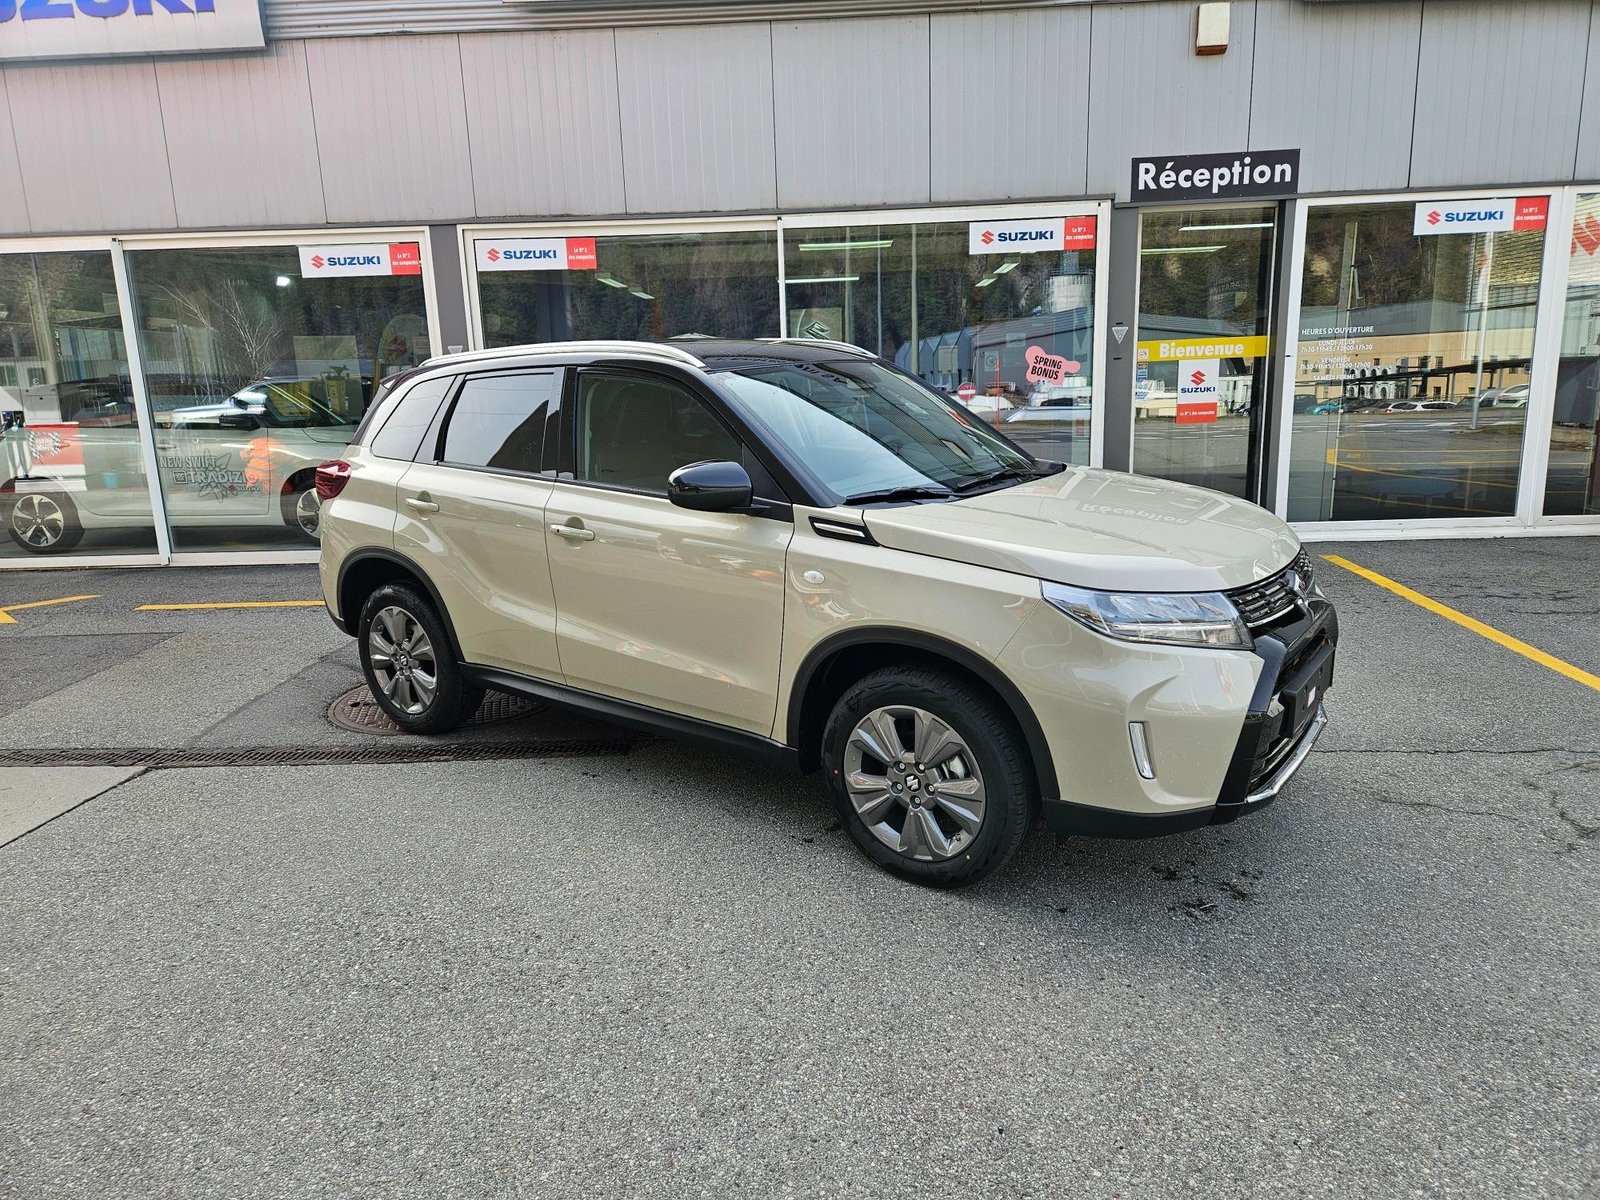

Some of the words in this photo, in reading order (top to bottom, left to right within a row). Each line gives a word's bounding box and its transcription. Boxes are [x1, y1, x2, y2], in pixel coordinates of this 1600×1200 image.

[1138, 156, 1292, 194] Réception
[1444, 210, 1504, 222] SUZUKI
[997, 230, 1053, 242] SUZUKI
[503, 249, 557, 259] SUZUKI
[327, 256, 381, 266] SUZUKI
[1301, 327, 1327, 335] HEURES
[1328, 326, 1374, 334] D'OUVERTURE
[1159, 341, 1245, 359] Bienvenue
[1033, 355, 1063, 370] SPRING
[1031, 365, 1060, 380] BONUS
[1180, 386, 1216, 394] SUZUKI
[159, 456, 182, 468] NEW
[185, 456, 217, 468] SWIFT
